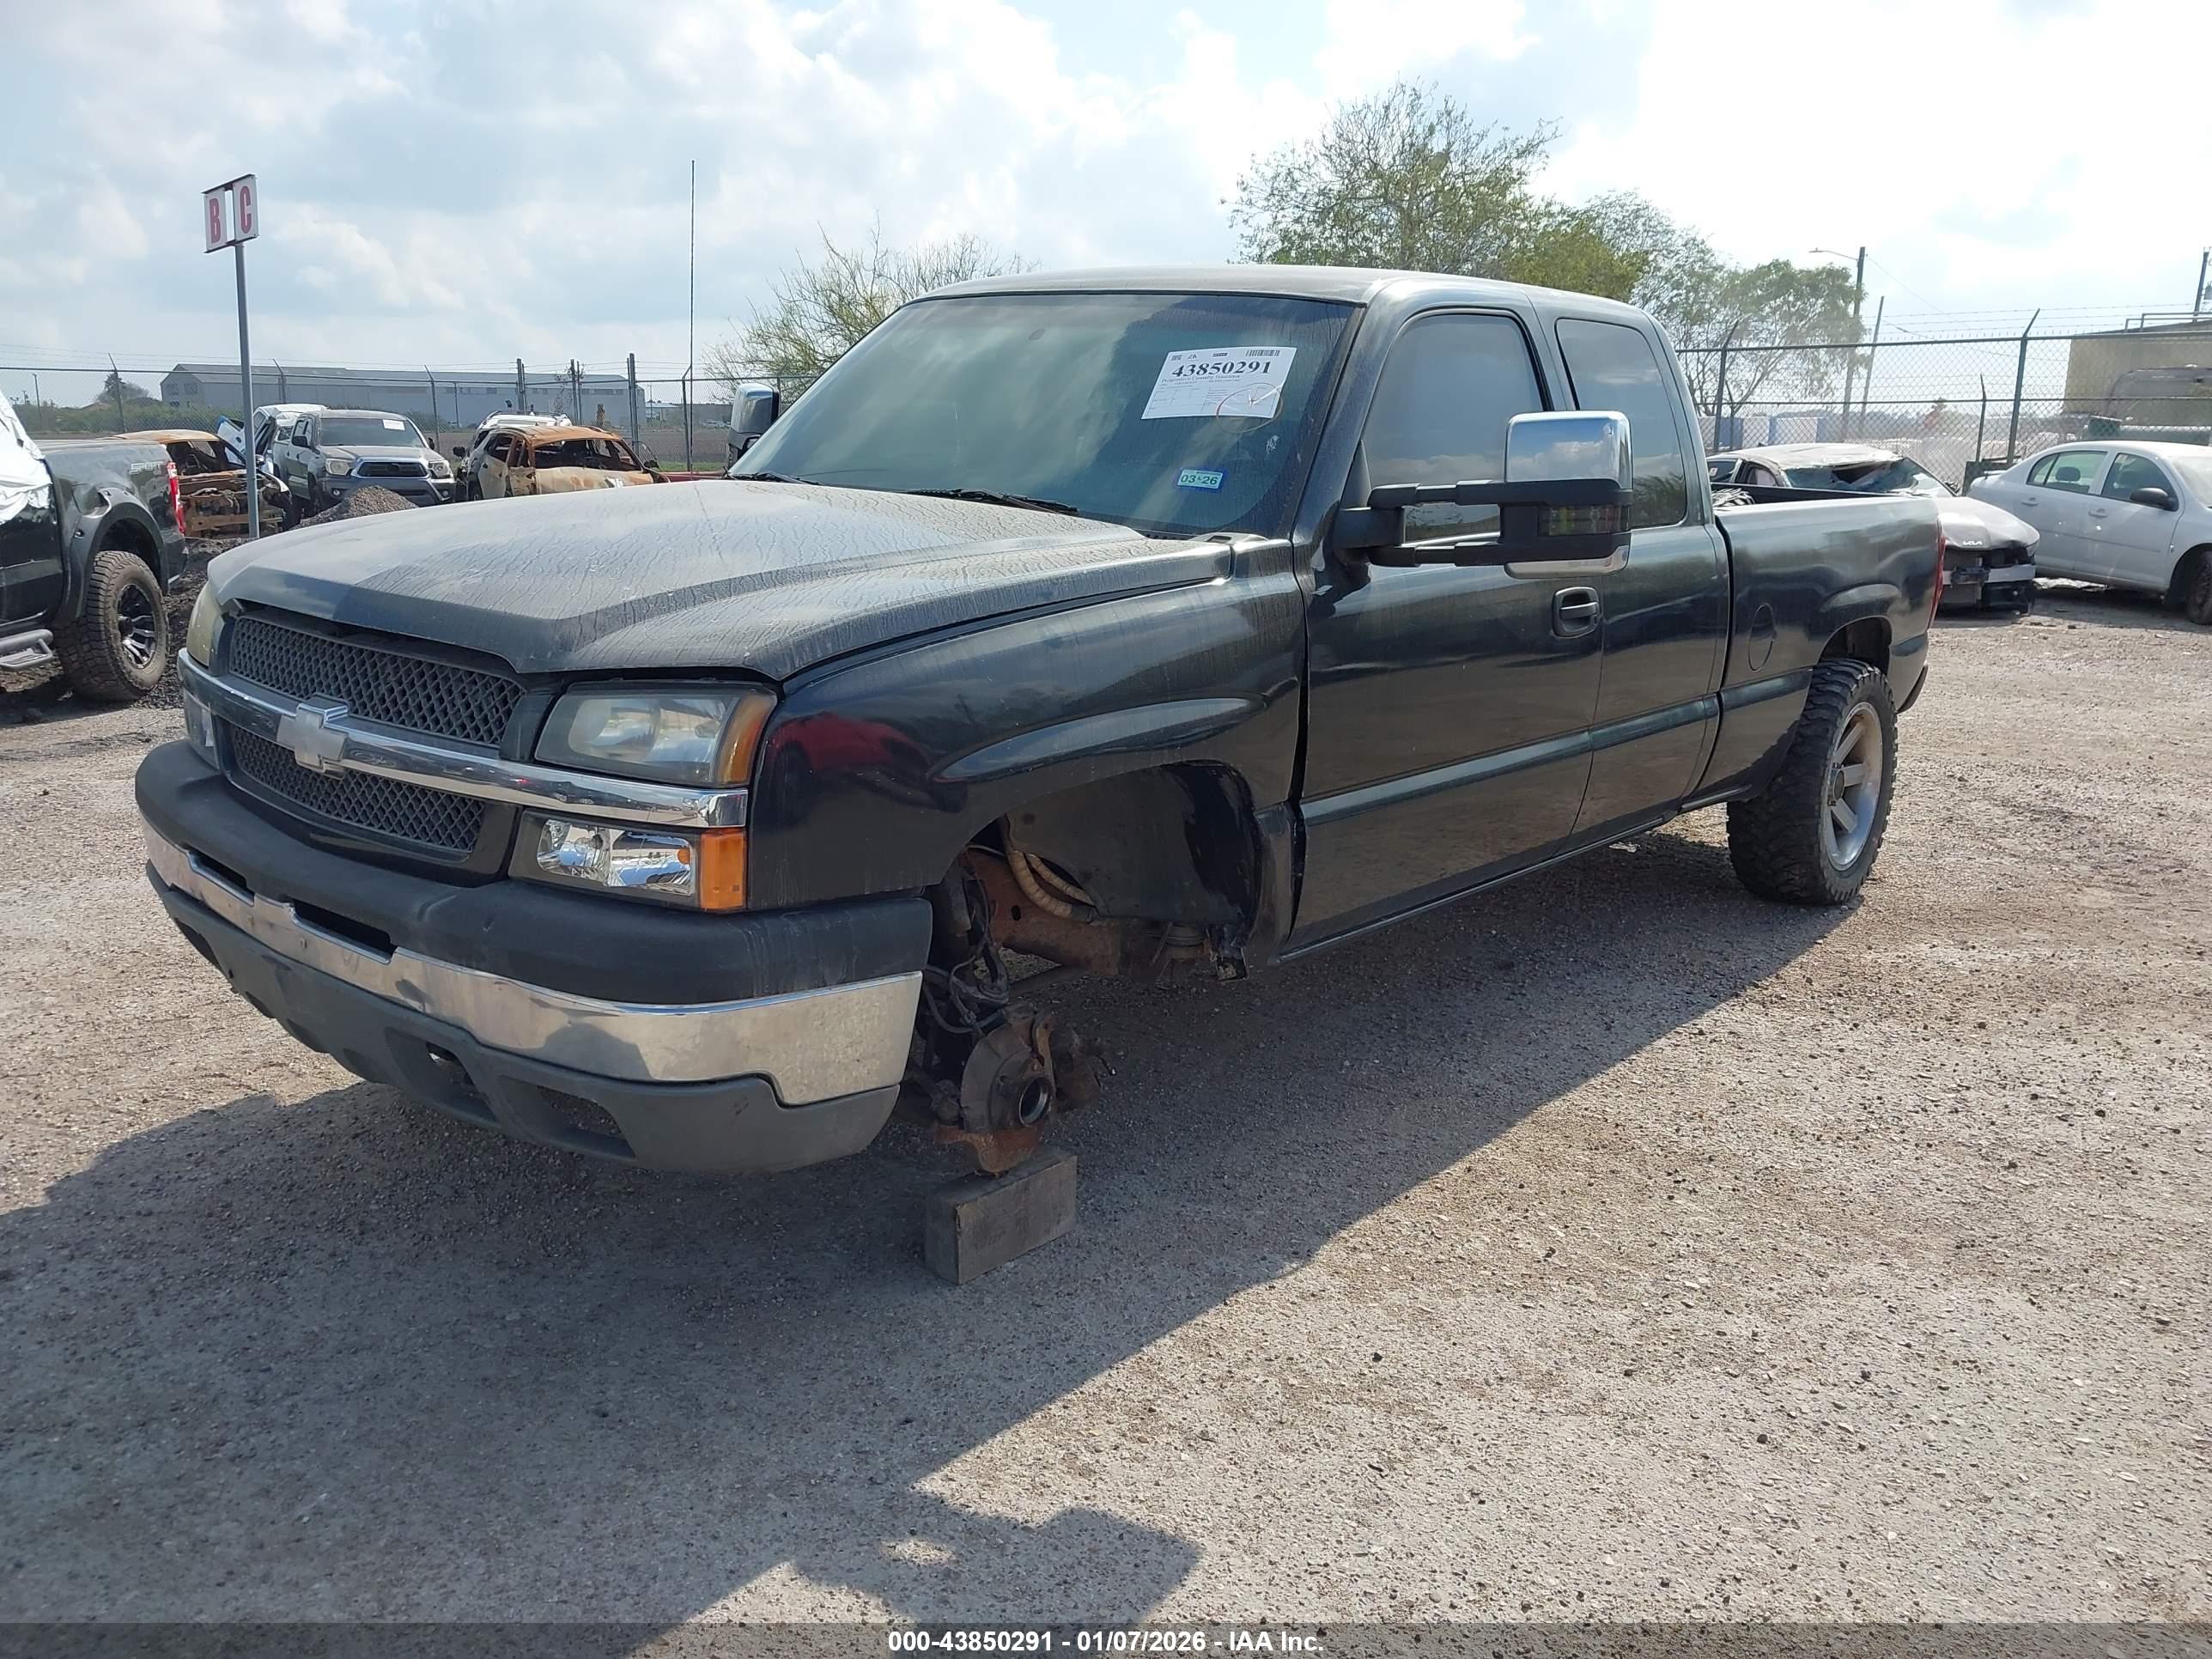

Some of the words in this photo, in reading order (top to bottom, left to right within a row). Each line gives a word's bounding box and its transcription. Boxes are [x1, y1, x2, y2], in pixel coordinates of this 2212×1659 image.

[209, 198, 222, 244] B
[240, 185, 252, 234] C
[1172, 361, 1272, 377] 43850291
[1181, 474, 1196, 483] 03
[1202, 476, 1218, 485] 26
